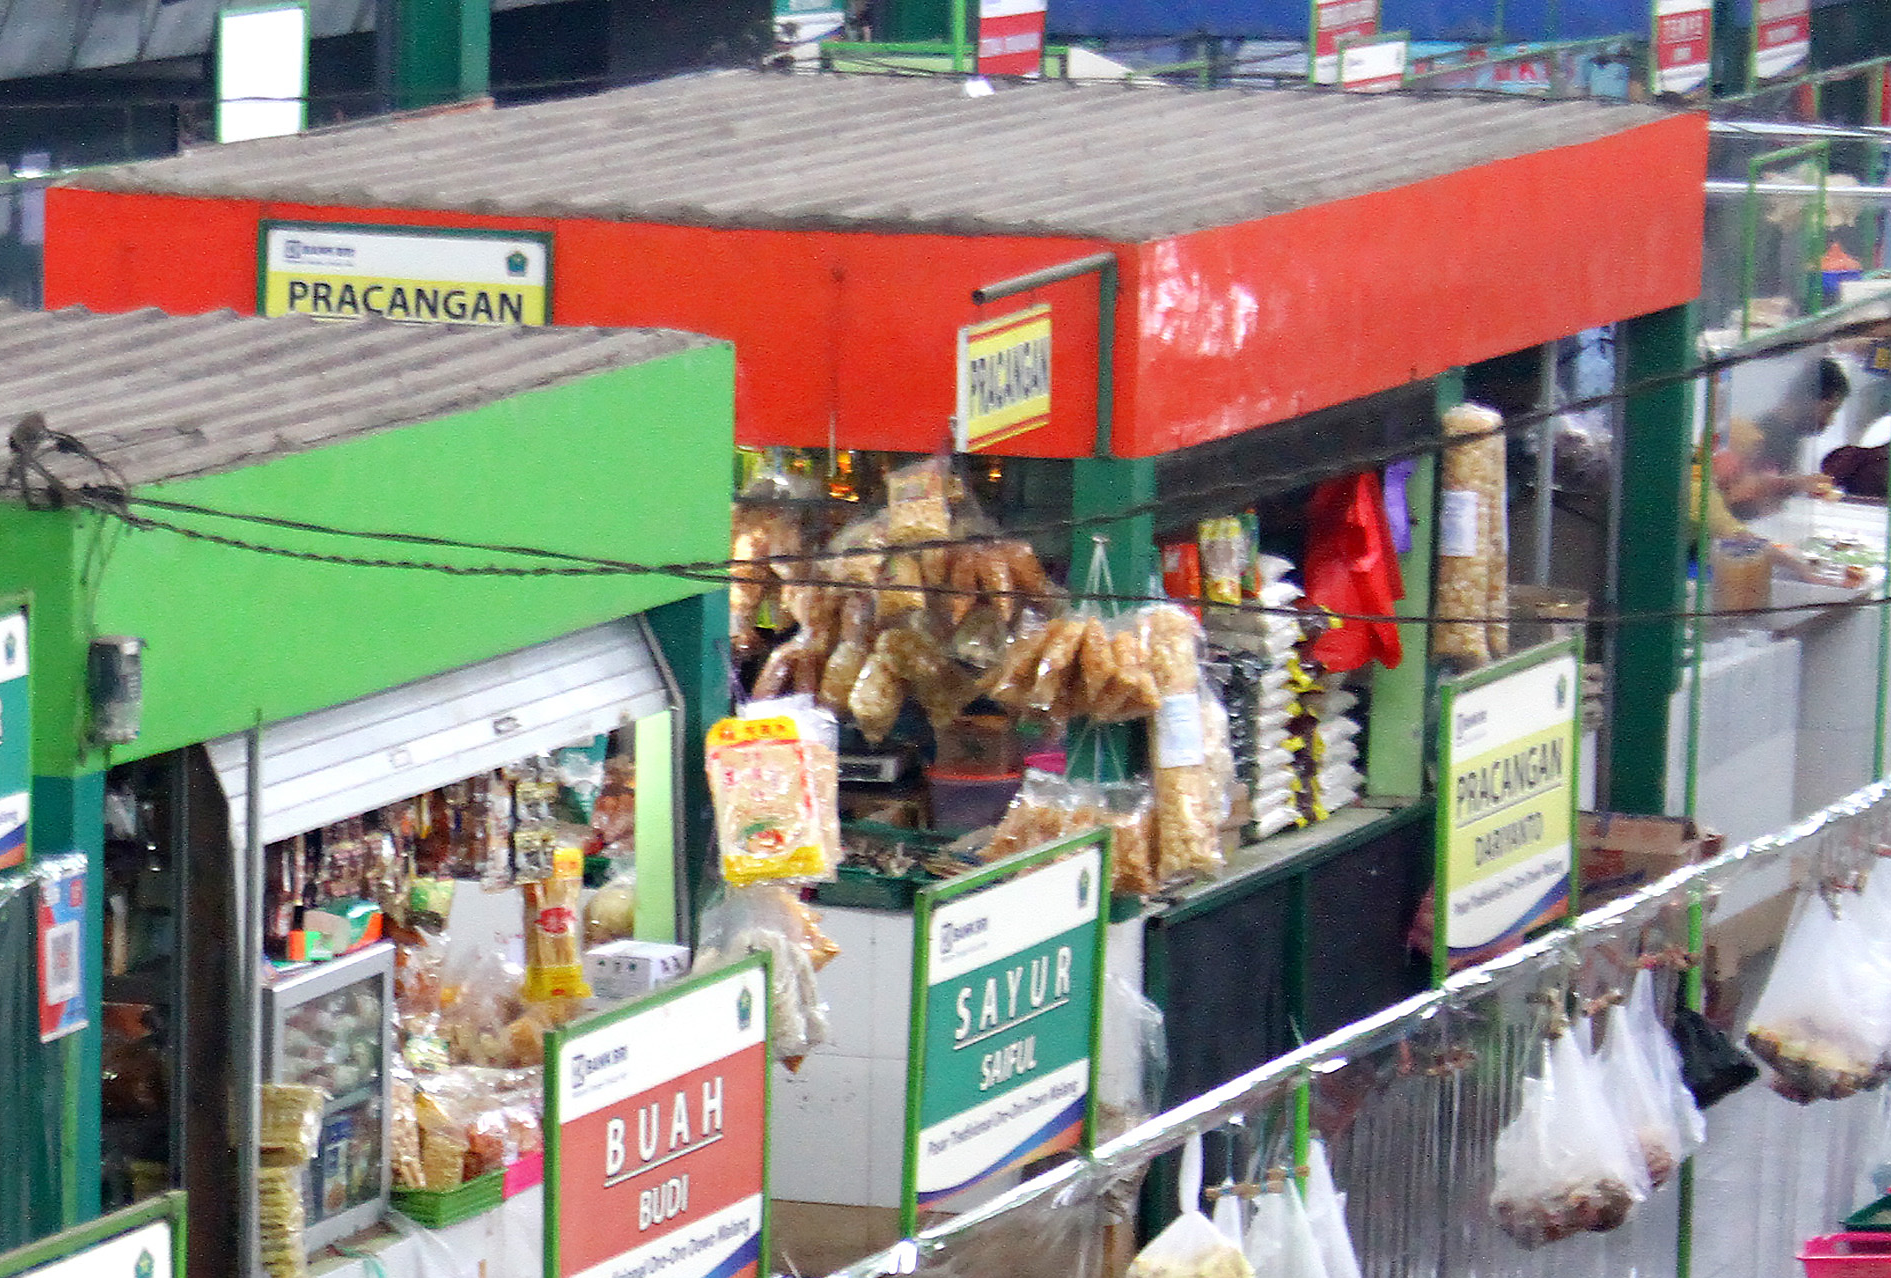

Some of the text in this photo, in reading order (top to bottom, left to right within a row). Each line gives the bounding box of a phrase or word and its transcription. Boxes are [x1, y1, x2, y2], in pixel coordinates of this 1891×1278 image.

[288, 280, 523, 322] PRACANGAN
[970, 335, 1051, 419] PRACANGAN
[1456, 737, 1564, 822] PRACANGAN
[955, 946, 1072, 1041] SAYUR
[979, 1035, 1037, 1091] SAIFUL
[606, 1075, 723, 1177] BUAH
[638, 1173, 689, 1231] BUDI
